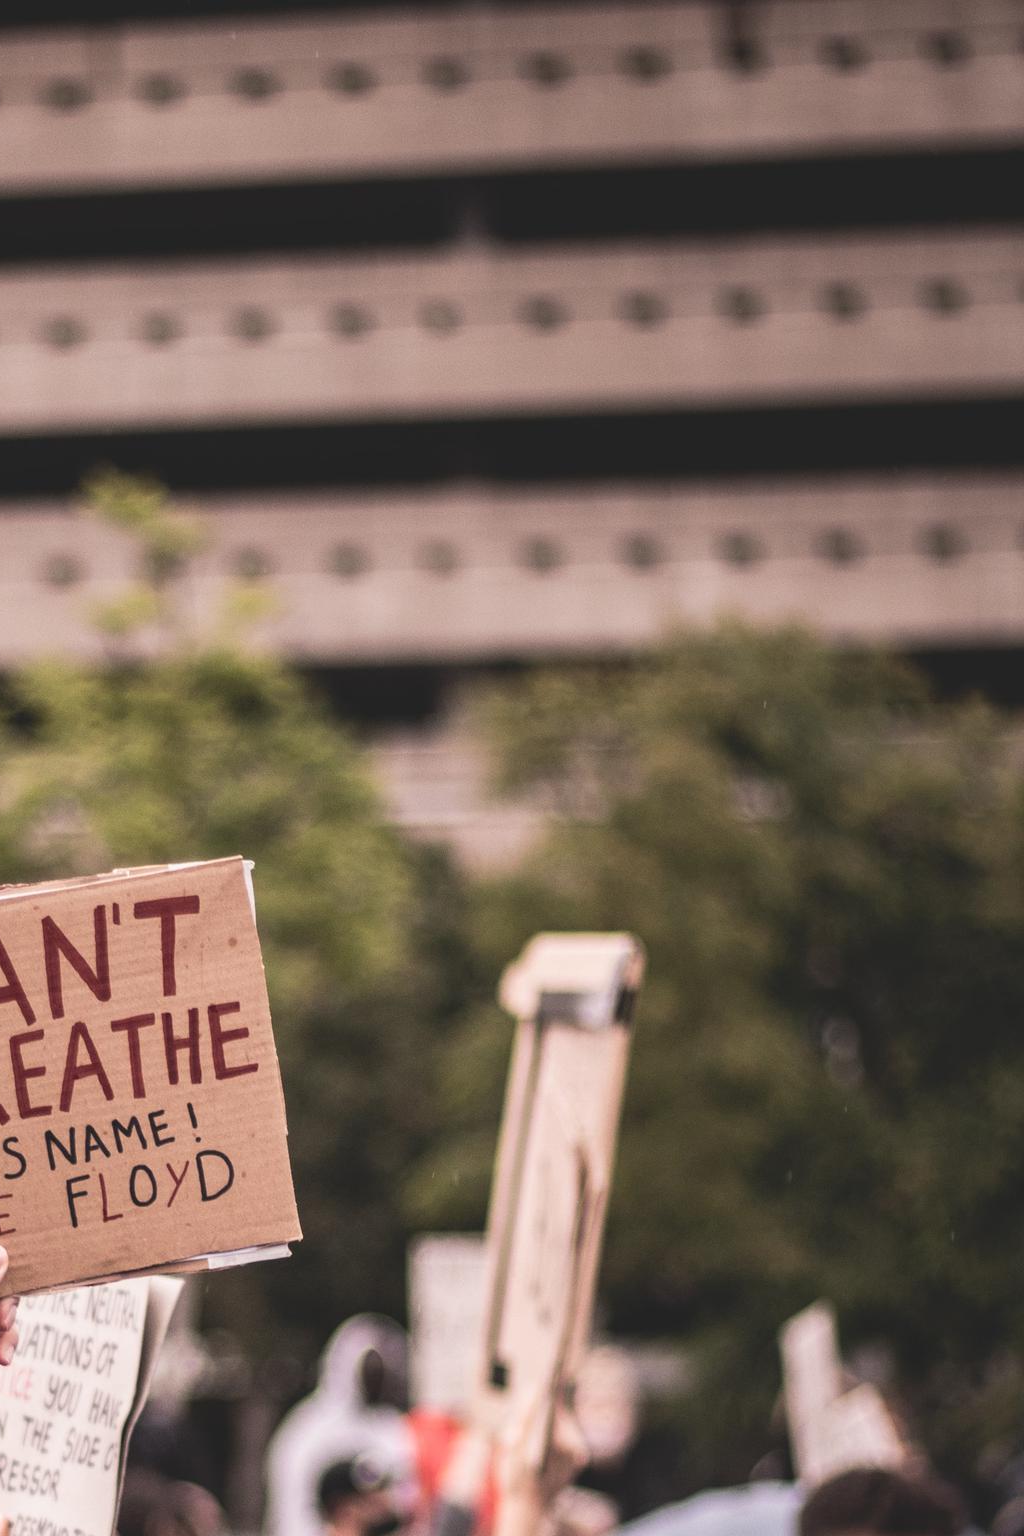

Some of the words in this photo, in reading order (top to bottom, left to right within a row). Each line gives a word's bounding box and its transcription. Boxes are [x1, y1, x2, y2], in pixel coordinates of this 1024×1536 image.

[66, 1149, 234, 1228] FLOYD
[16, 1321, 93, 1371] UATIONS
[95, 1341, 119, 1378] OF
[44, 1373, 83, 1417] YOU
[22, 1414, 53, 1455] THE
[62, 1426, 101, 1468] SIDE
